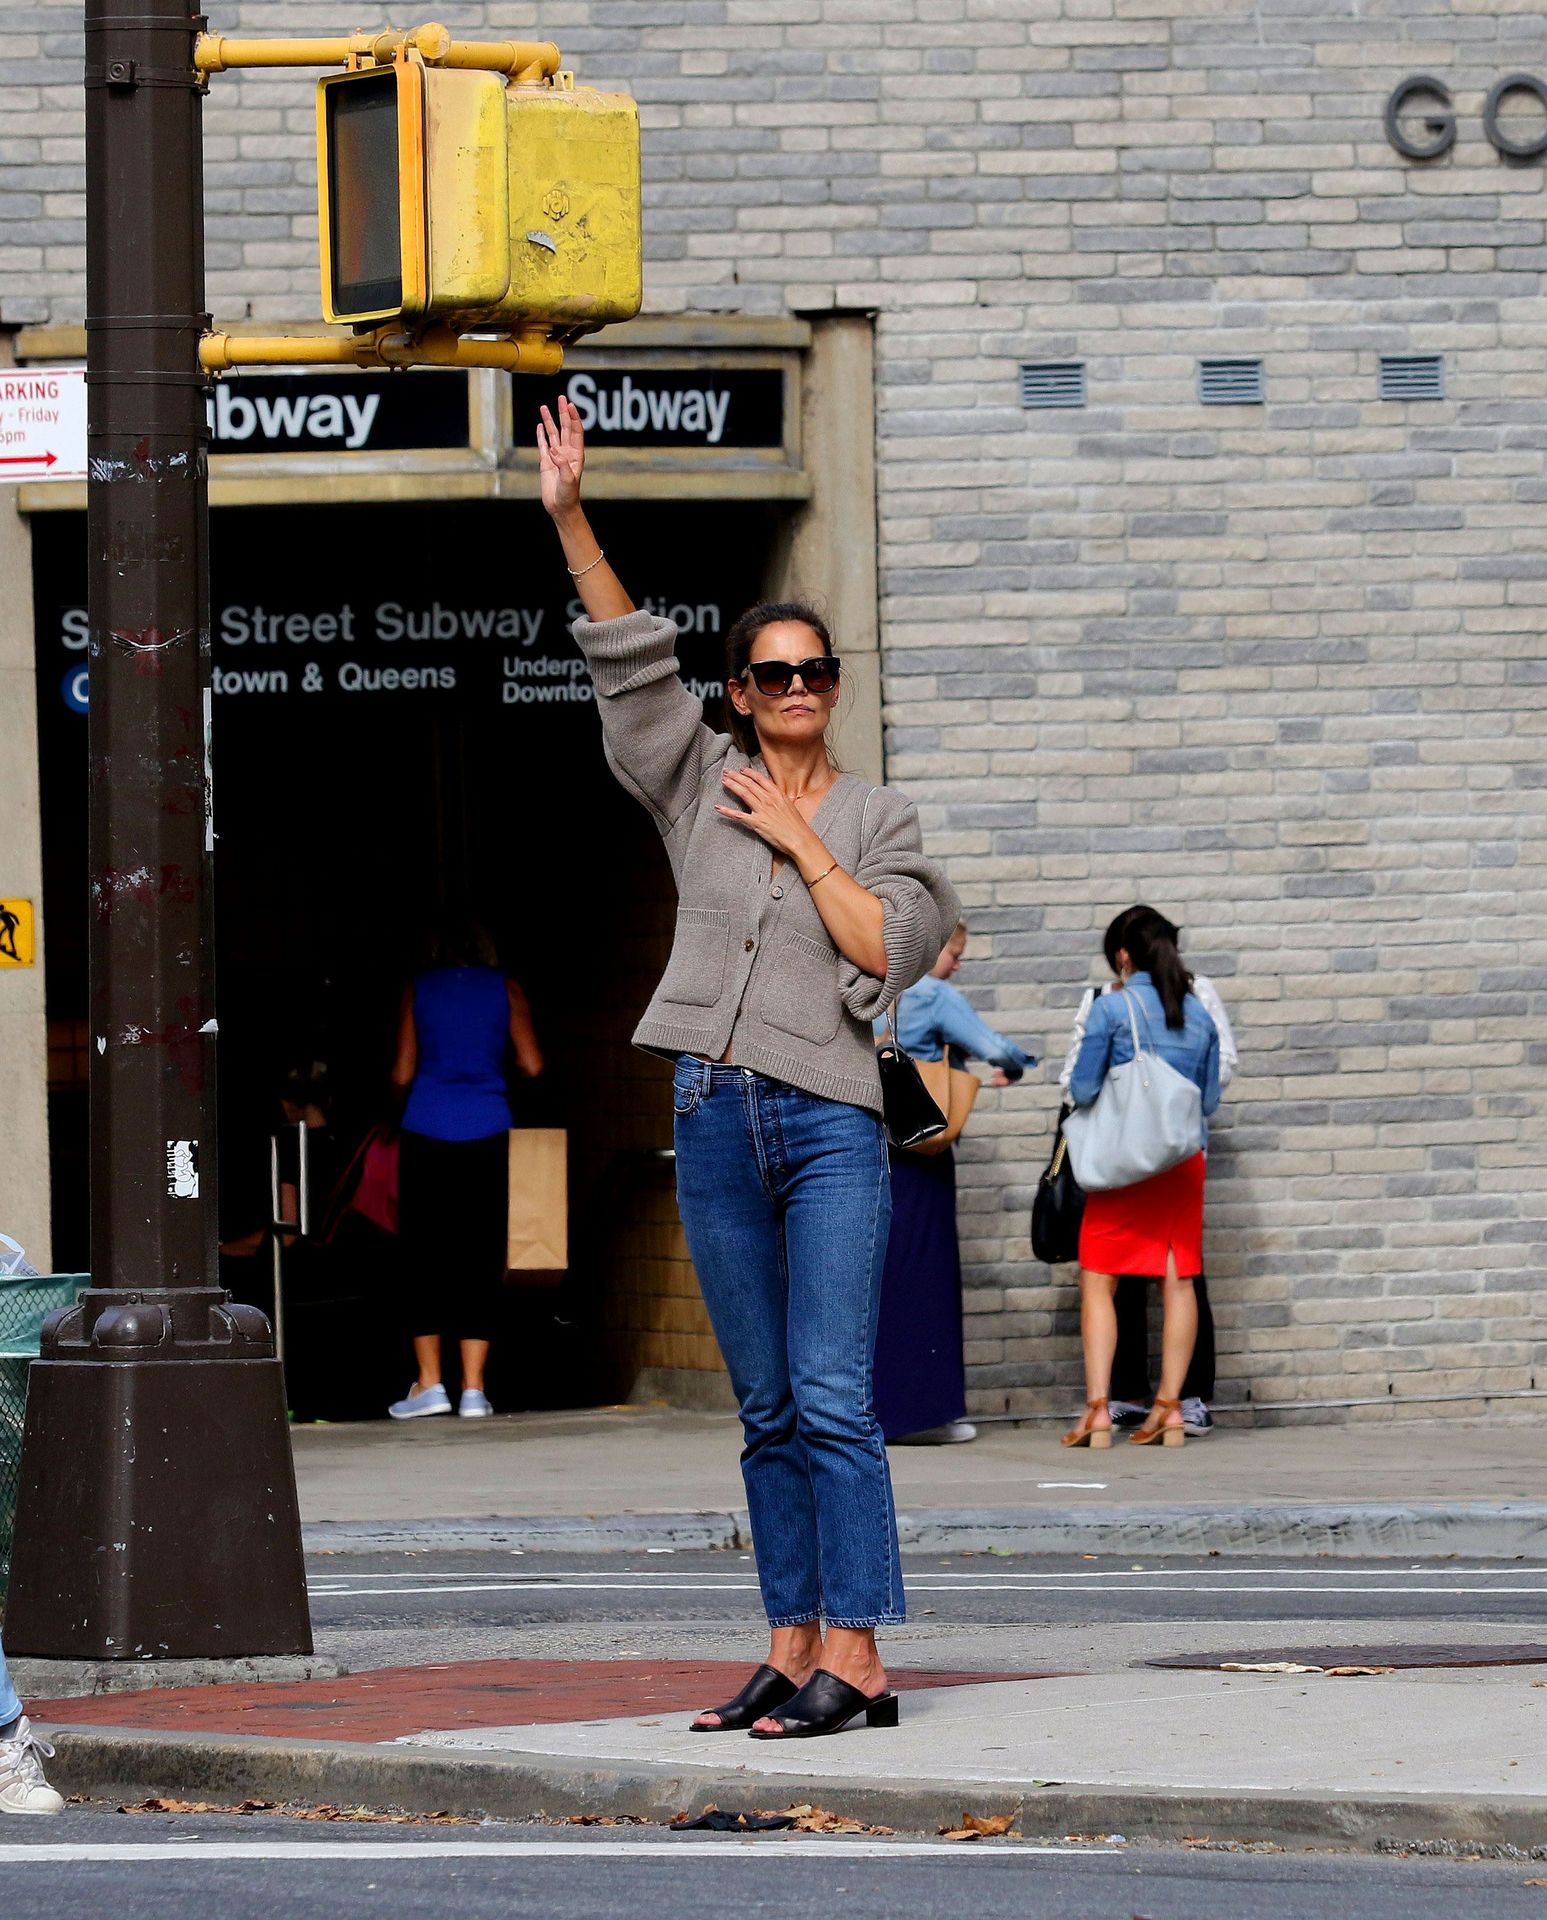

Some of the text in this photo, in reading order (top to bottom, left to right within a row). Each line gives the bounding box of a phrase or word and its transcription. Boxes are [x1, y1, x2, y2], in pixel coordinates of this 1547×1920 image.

[1384, 73, 1547, 163] GO
[0, 381, 59, 400] RKING
[18, 407, 60, 425] Friday
[207, 384, 380, 448] bway
[567, 374, 730, 443] Subway
[220, 604, 356, 646] Street
[375, 601, 545, 647] Subway
[211, 661, 457, 695] town & Queens
[503, 655, 591, 681] Underp
[502, 680, 597, 704] Downto
